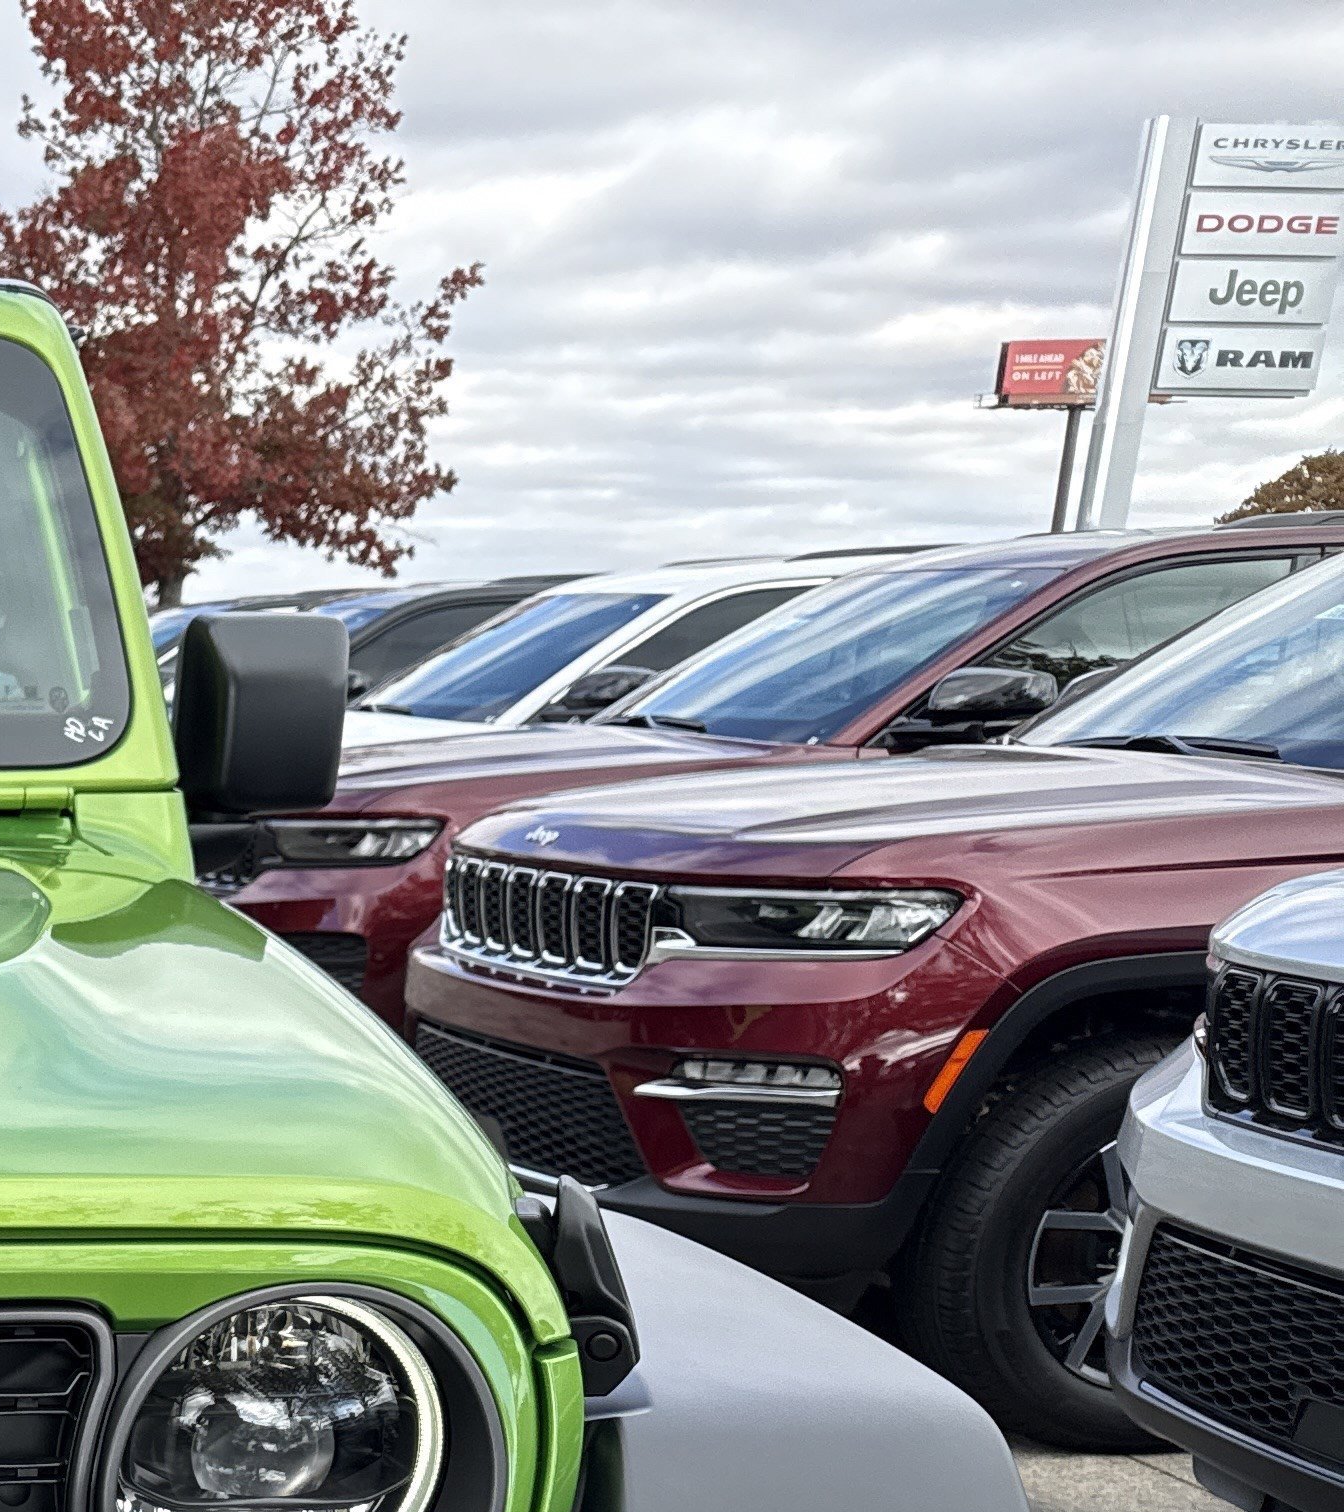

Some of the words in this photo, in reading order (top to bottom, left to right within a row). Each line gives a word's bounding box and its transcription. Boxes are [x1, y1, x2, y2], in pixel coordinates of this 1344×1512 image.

[1196, 214, 1340, 235] DODGE
[1209, 269, 1304, 314] Jeep
[1215, 349, 1314, 369] RAM
[1012, 371, 1031, 381] ON
[1034, 371, 1062, 381] LEFT
